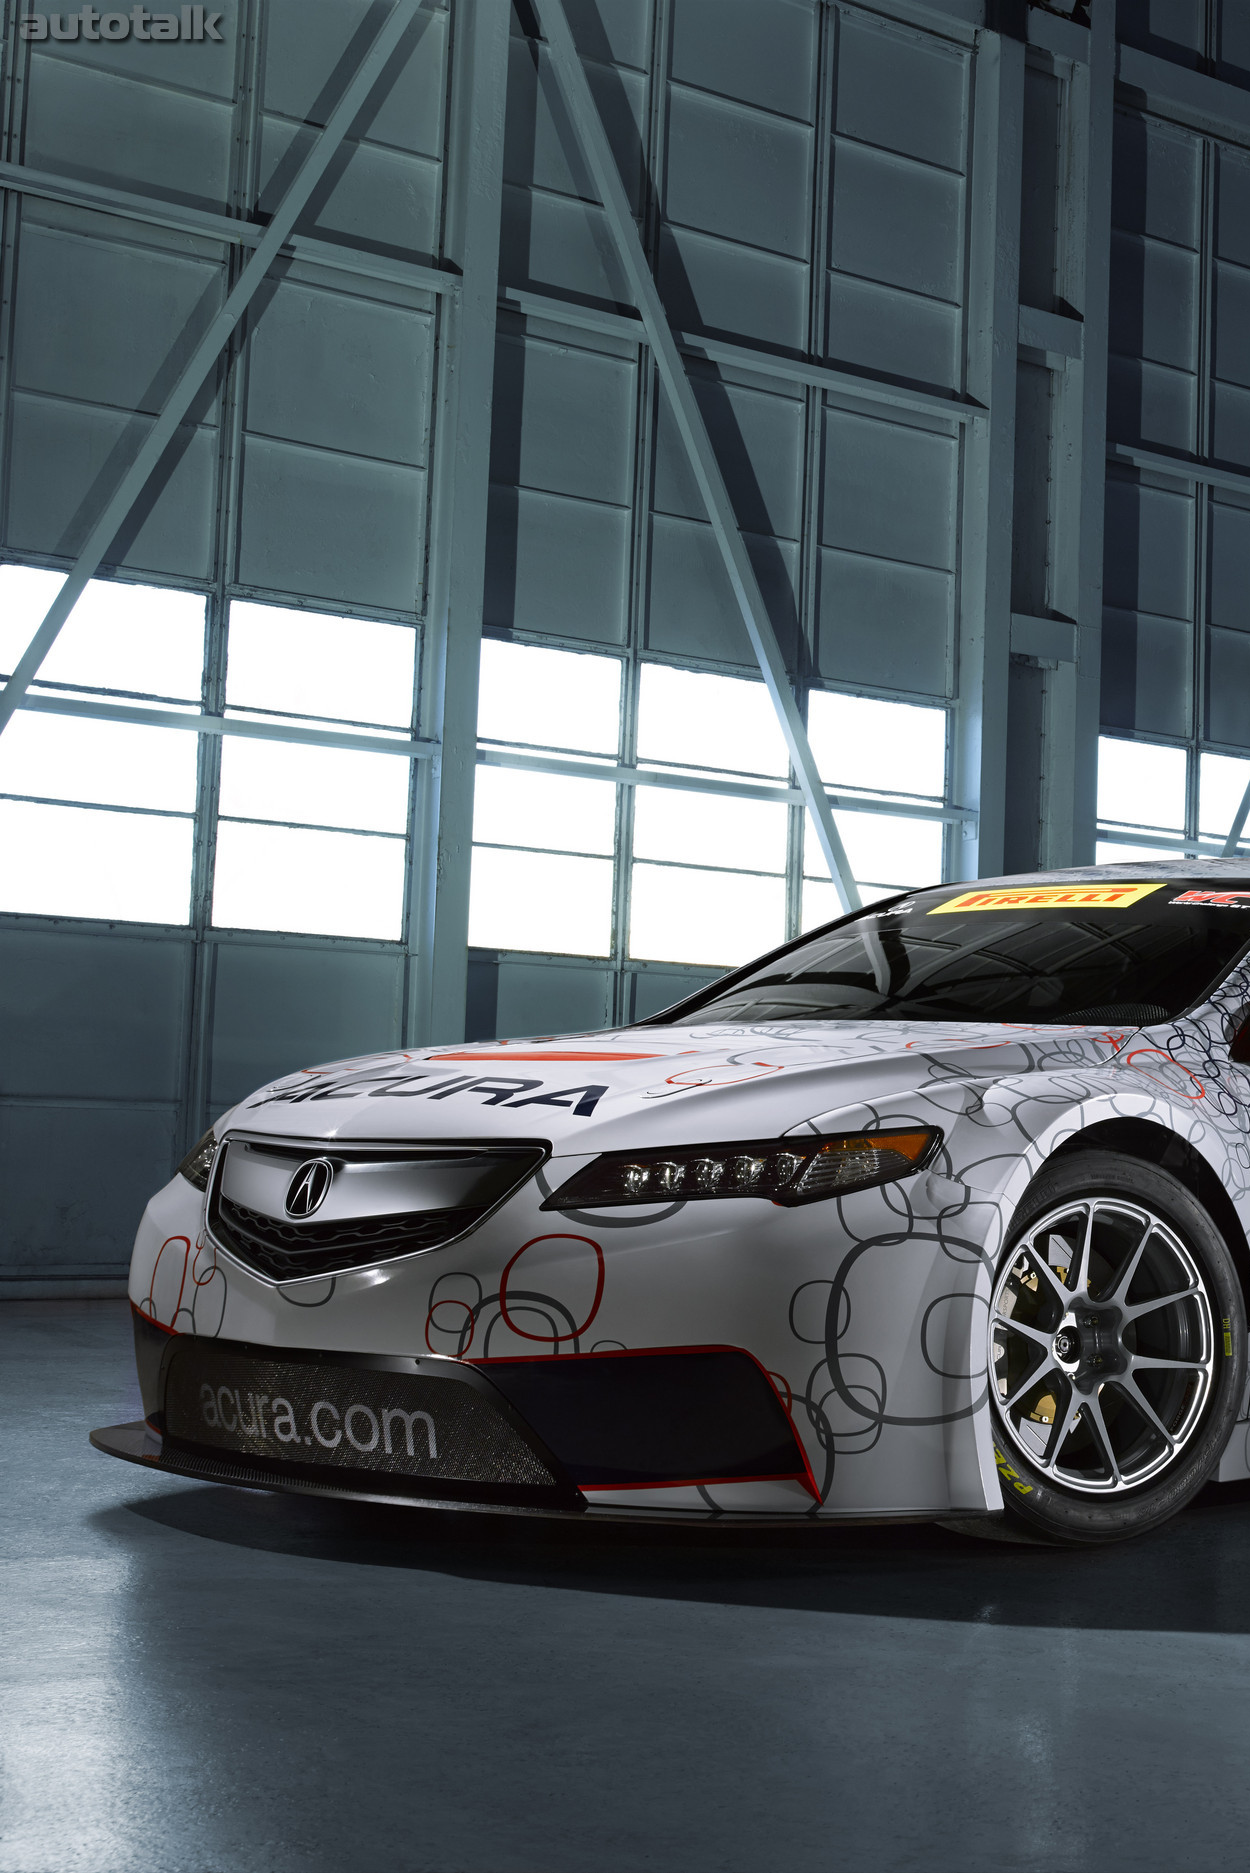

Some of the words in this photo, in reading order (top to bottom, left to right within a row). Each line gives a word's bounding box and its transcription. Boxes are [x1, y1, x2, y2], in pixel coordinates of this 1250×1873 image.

[955, 888, 1138, 908] PIRELLI
[246, 1075, 610, 1117] ACURA
[1223, 1318, 1230, 1329] DH
[201, 1383, 437, 1459] acura.com
